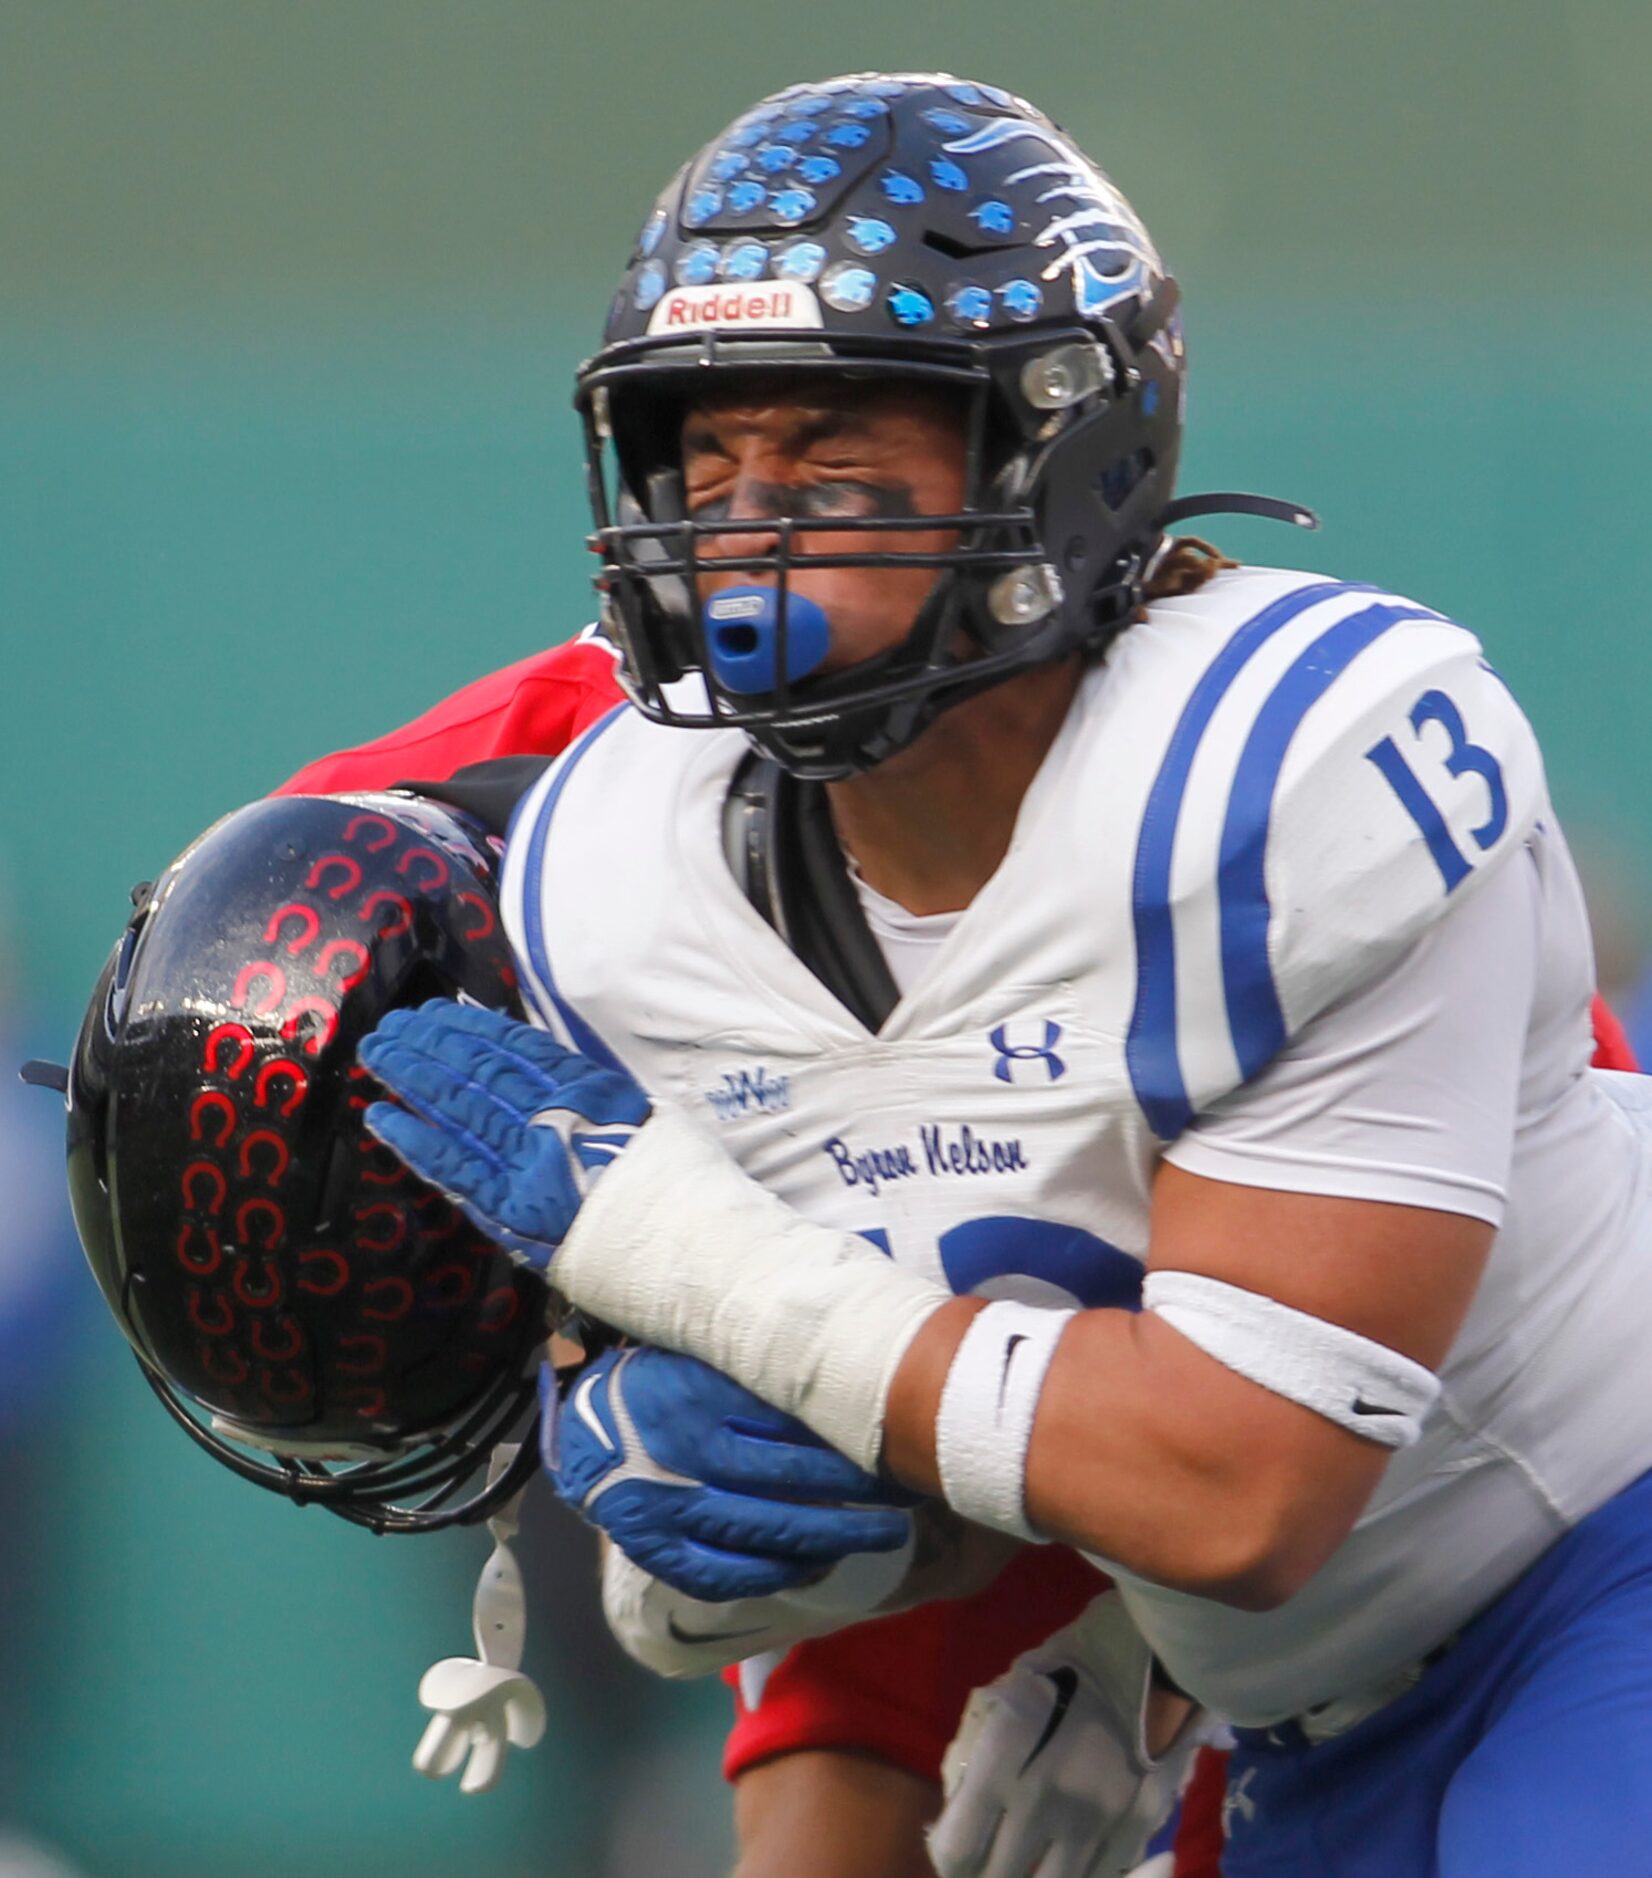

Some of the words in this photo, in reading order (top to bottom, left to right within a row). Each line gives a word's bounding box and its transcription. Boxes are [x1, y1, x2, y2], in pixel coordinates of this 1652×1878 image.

[667, 292, 793, 325] Riddell
[1364, 688, 1509, 897] 13
[824, 1136, 917, 1197] Byron
[920, 1124, 1027, 1176] Nelson
